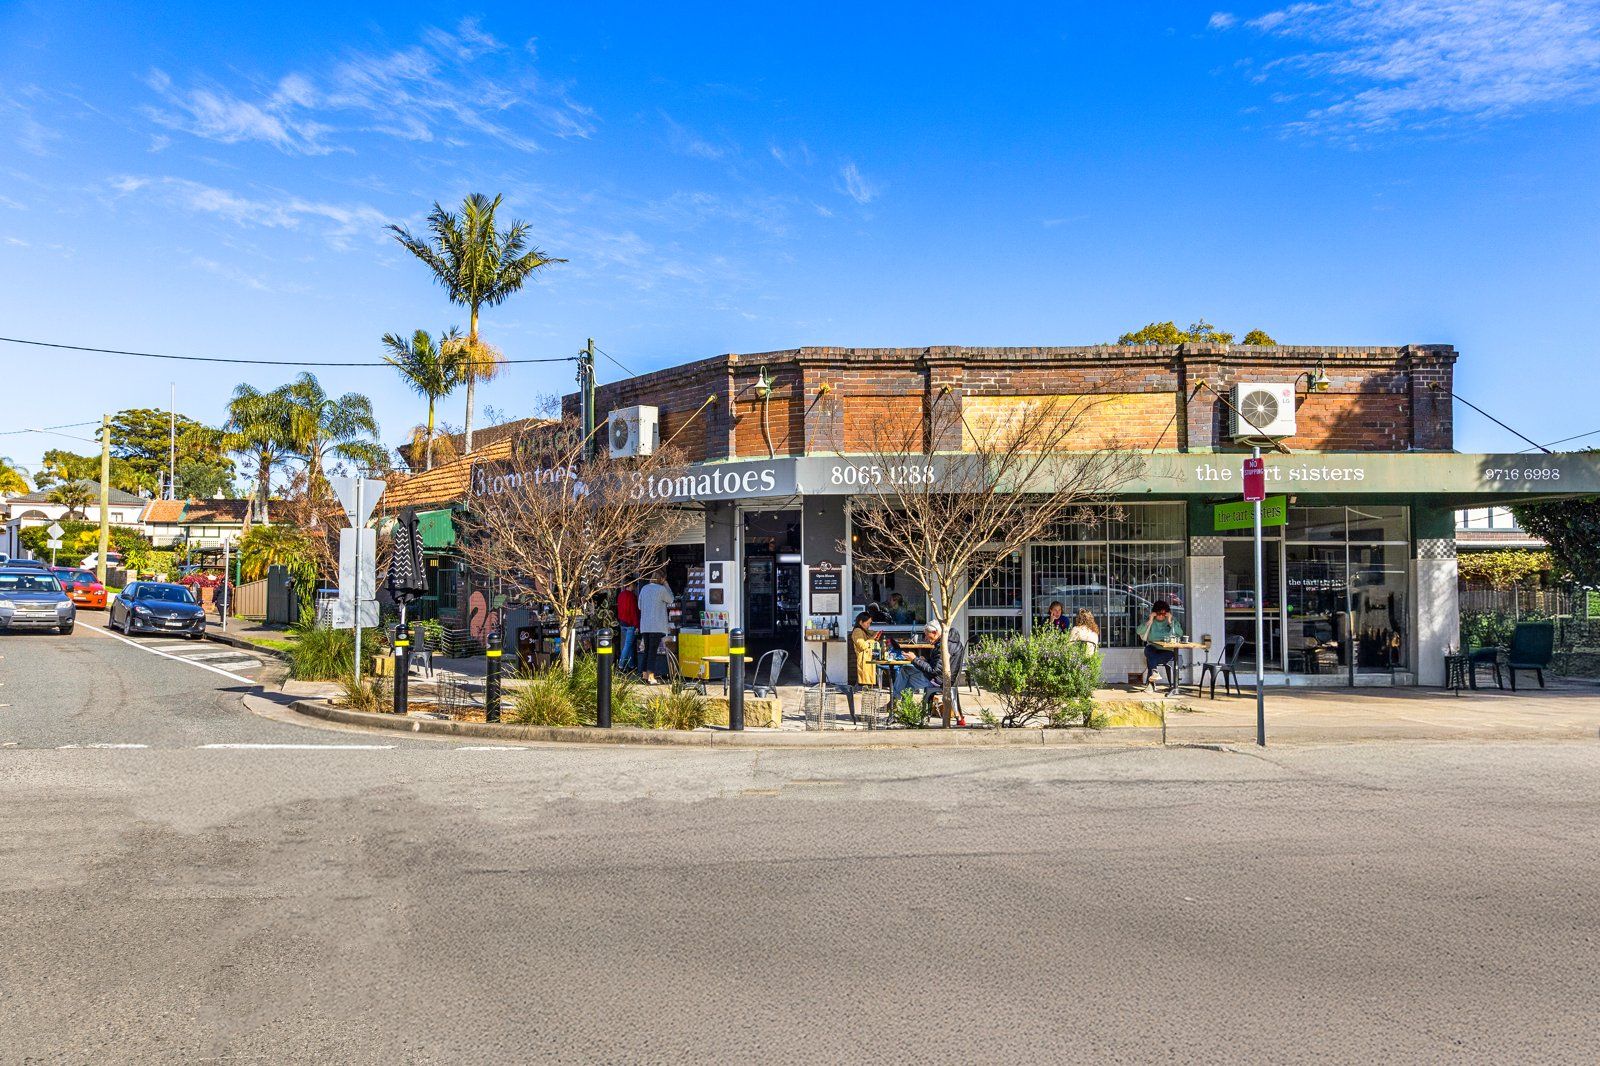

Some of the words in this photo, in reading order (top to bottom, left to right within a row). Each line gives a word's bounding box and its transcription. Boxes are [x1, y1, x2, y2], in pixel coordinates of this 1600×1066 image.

[1249, 460, 1258, 468] NO
[830, 465, 882, 485] 8065
[889, 465, 936, 485] 1288
[1195, 463, 1233, 481] the
[1240, 463, 1282, 481] trt
[1288, 463, 1365, 481] sisters
[1485, 468, 1519, 480] 9716
[1523, 468, 1560, 480] 6998
[1218, 510, 1231, 523] the
[1232, 509, 1249, 522] tart
[1250, 505, 1281, 520] ssters
[1288, 578, 1302, 586] the
